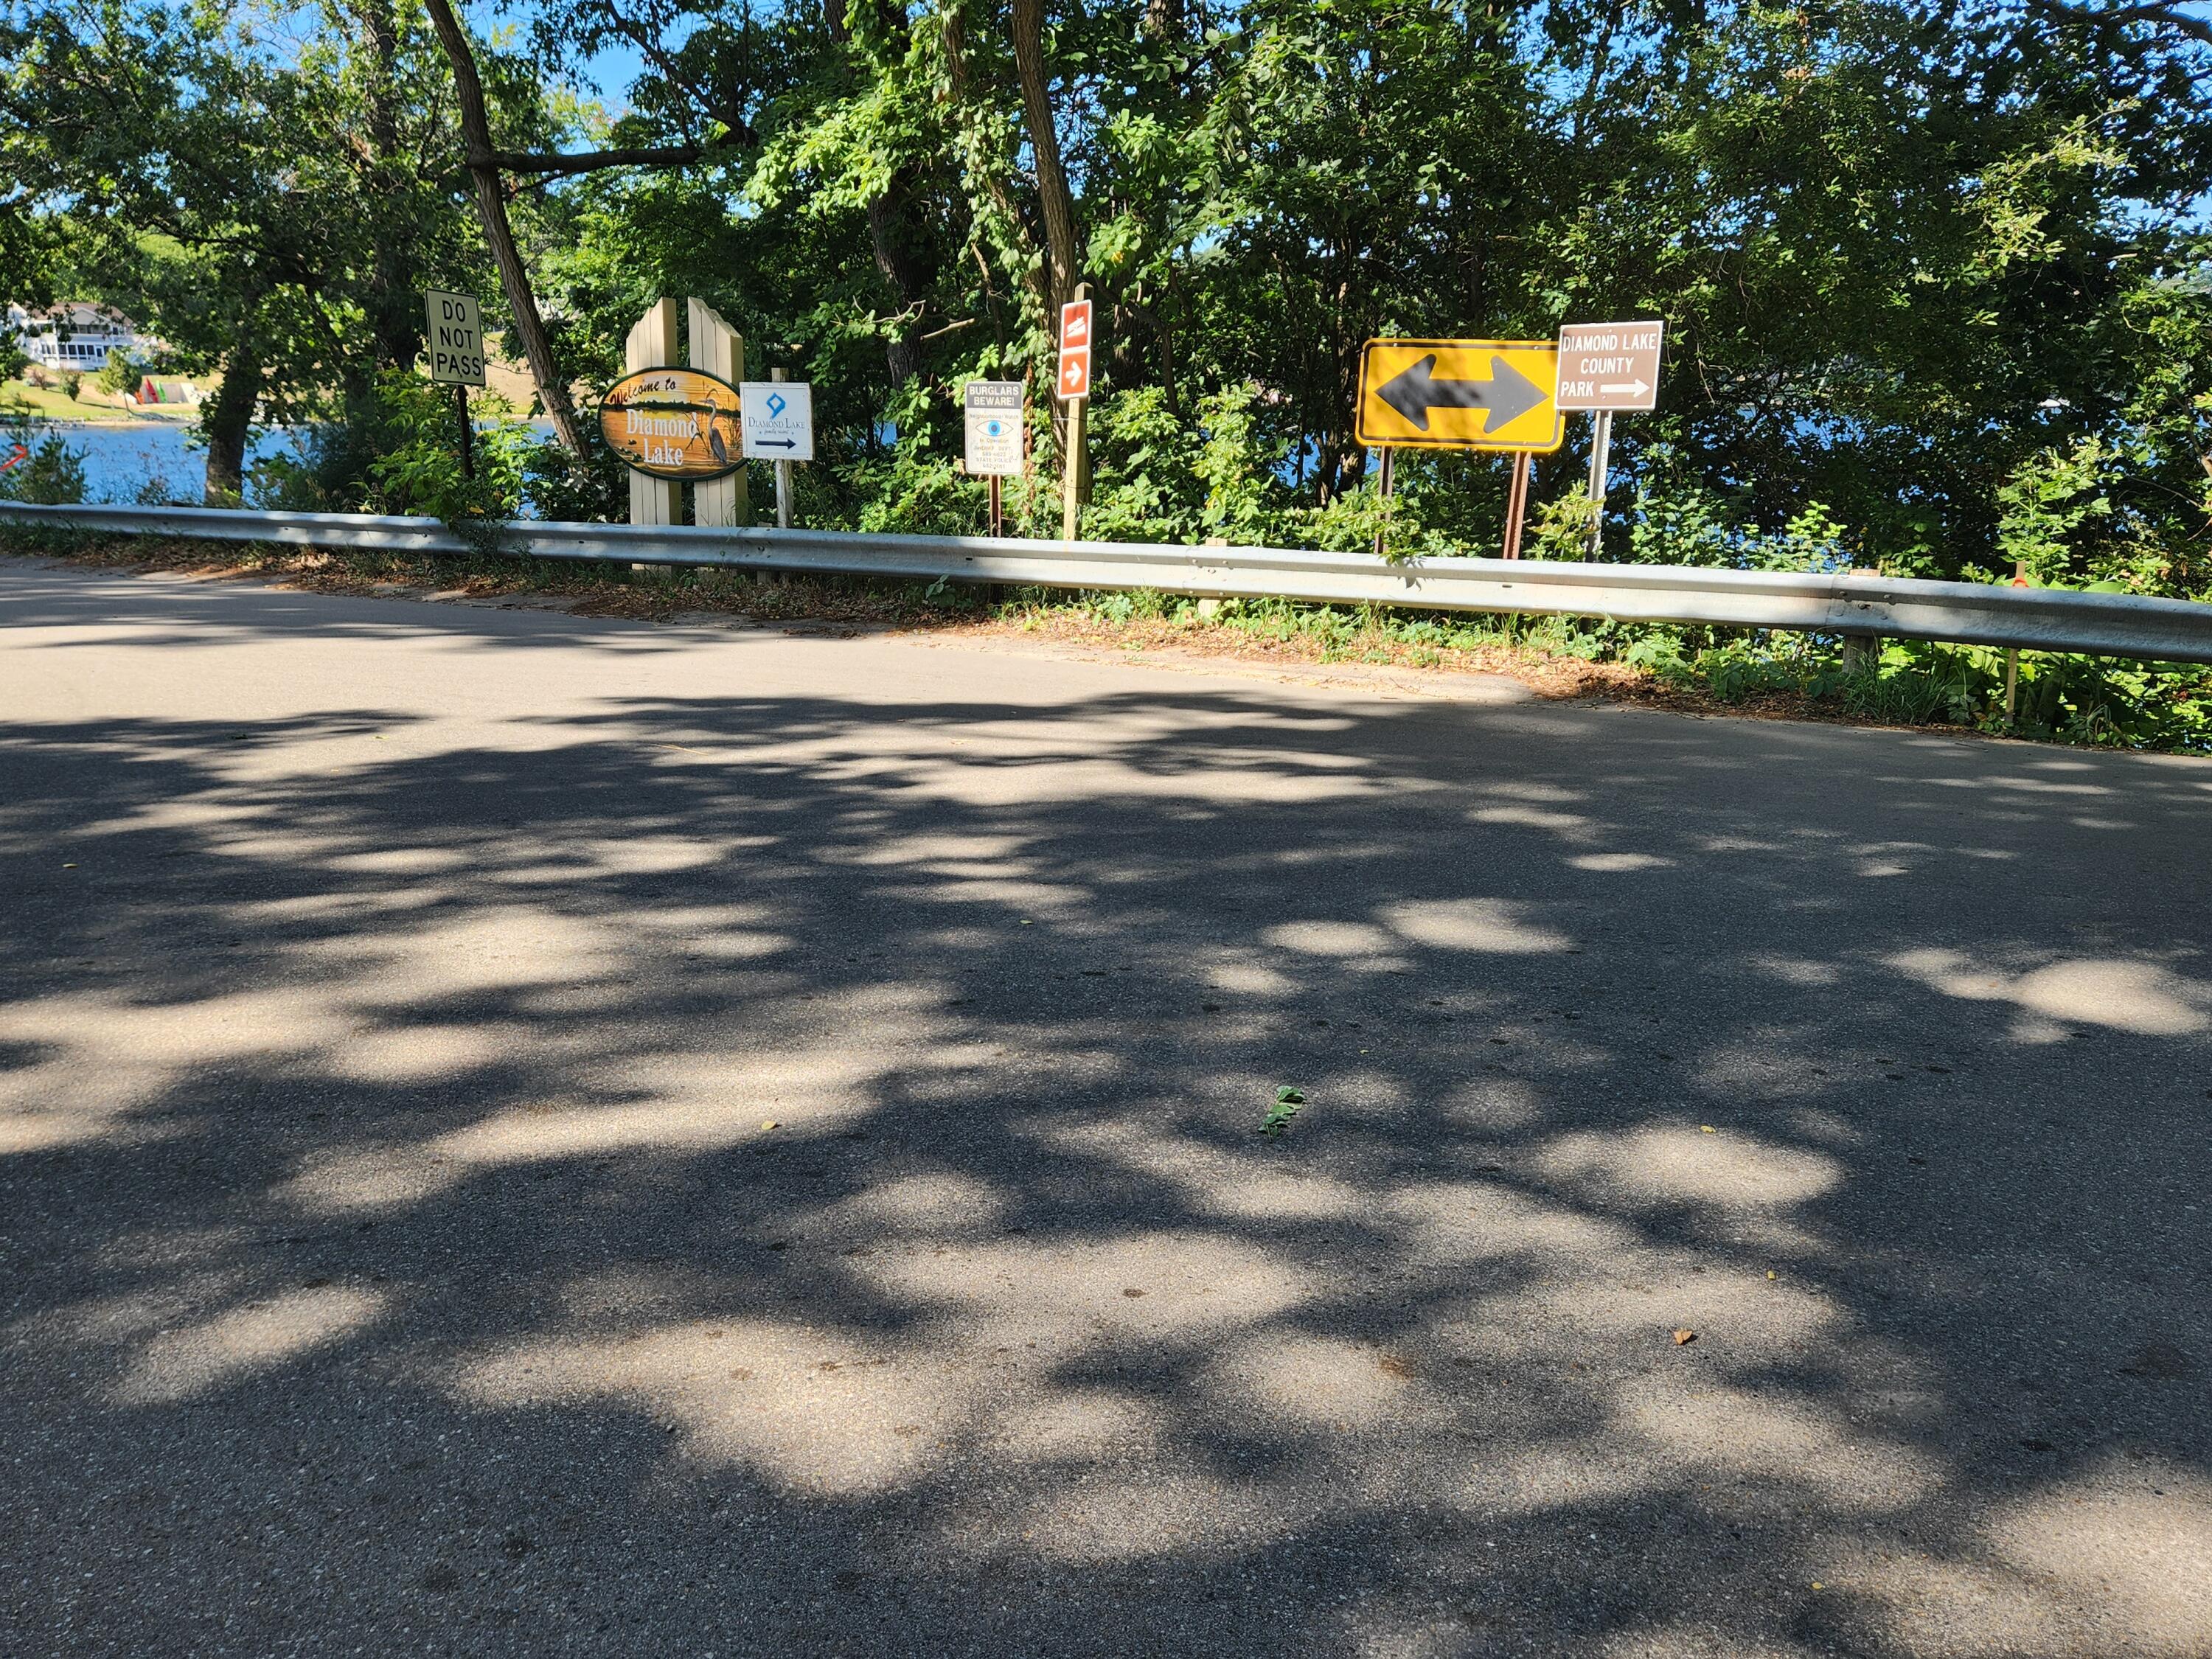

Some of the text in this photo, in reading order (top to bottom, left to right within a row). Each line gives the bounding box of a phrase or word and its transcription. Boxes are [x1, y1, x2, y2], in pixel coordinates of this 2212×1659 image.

[442, 300, 465, 322] DO
[439, 326, 473, 349] NOT
[1562, 333, 1658, 352] DIAMOND LAKE
[437, 352, 481, 376] PASS
[1580, 357, 1634, 375] COUNTY
[610, 377, 676, 408] Welcome to
[969, 386, 1019, 396] BURGLARS
[1560, 380, 1594, 397] PARK
[973, 397, 1015, 406] BEWARE!
[626, 408, 698, 439] Diamond
[644, 438, 684, 466] Lake
